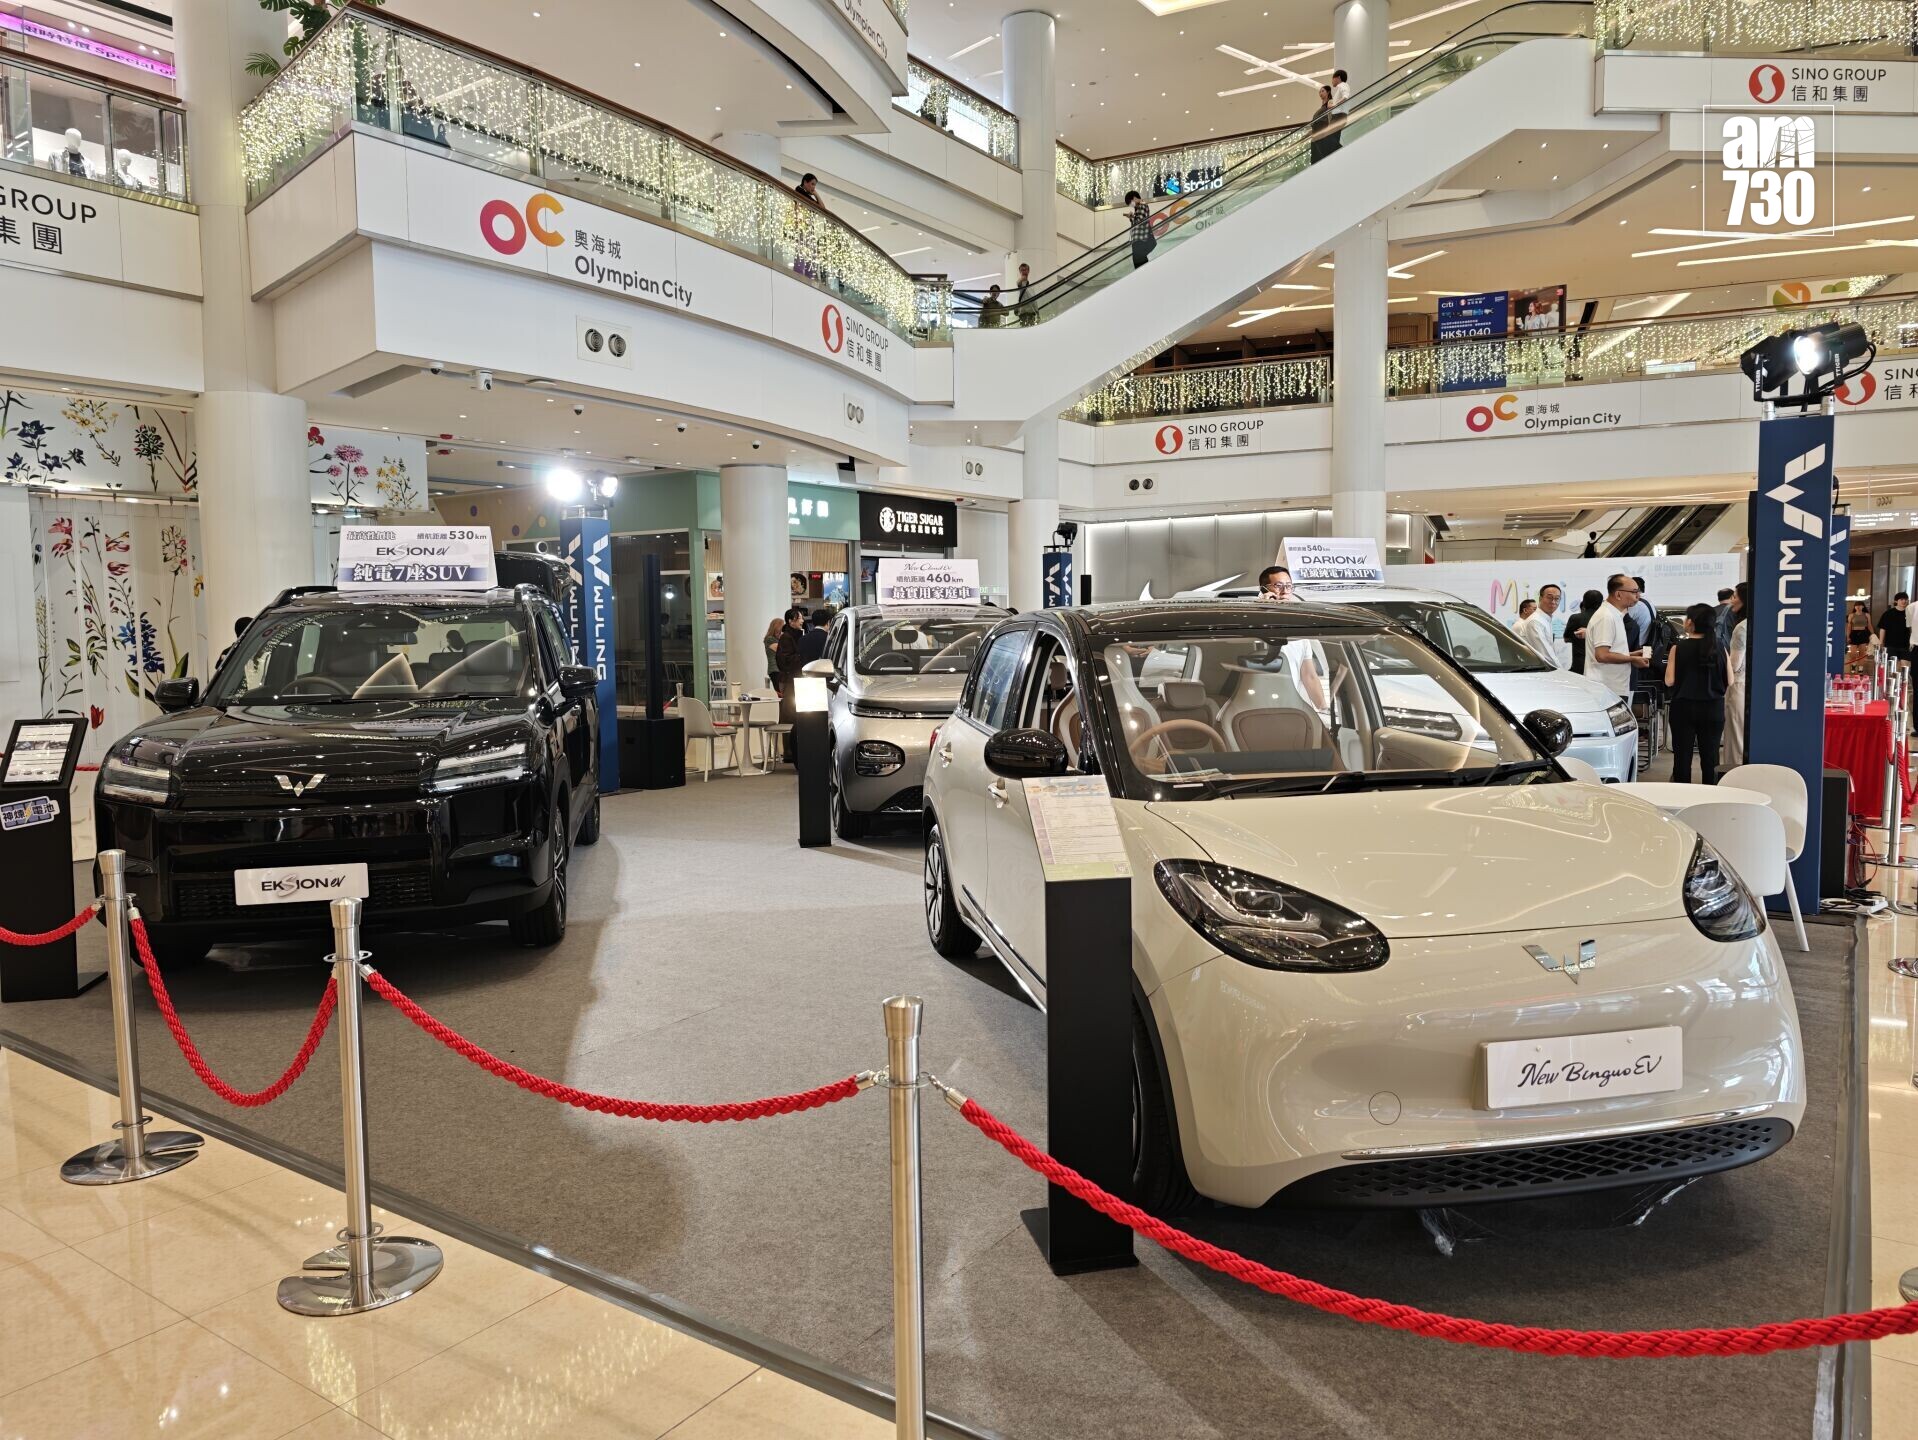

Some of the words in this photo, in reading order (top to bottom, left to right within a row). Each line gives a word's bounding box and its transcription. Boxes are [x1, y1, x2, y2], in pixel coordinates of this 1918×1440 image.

[875, 33, 888, 59] City
[1792, 67, 1829, 80] SINO
[1833, 68, 1887, 81] GROUP
[1791, 85, 1868, 102] 信和集團
[480, 193, 565, 255] OC
[574, 229, 622, 259] 奧海城
[575, 255, 660, 294] Olympian
[662, 279, 693, 307] City
[845, 316, 864, 338] SINO
[865, 327, 888, 351] GROUP
[846, 337, 882, 372] 信和集團
[1884, 366, 1918, 381] SIN
[1466, 394, 1519, 432] OC
[1525, 403, 1560, 416] 奧海城
[1525, 415, 1590, 430] Olympian
[1592, 412, 1622, 425] City
[1188, 423, 1217, 435] SINO
[1220, 420, 1264, 432] GROUP
[1188, 434, 1249, 451] 信和集團
[896, 510, 918, 524] TIGER
[919, 513, 944, 526] SUGAR
[892, 585, 972, 600] 最實用家庭車
[1490, 578, 1567, 613] Mii
[569, 586, 580, 655] WULI
[593, 585, 606, 681] WULING
[1774, 539, 1804, 710] WULING
[1517, 1060, 1559, 1088] New
